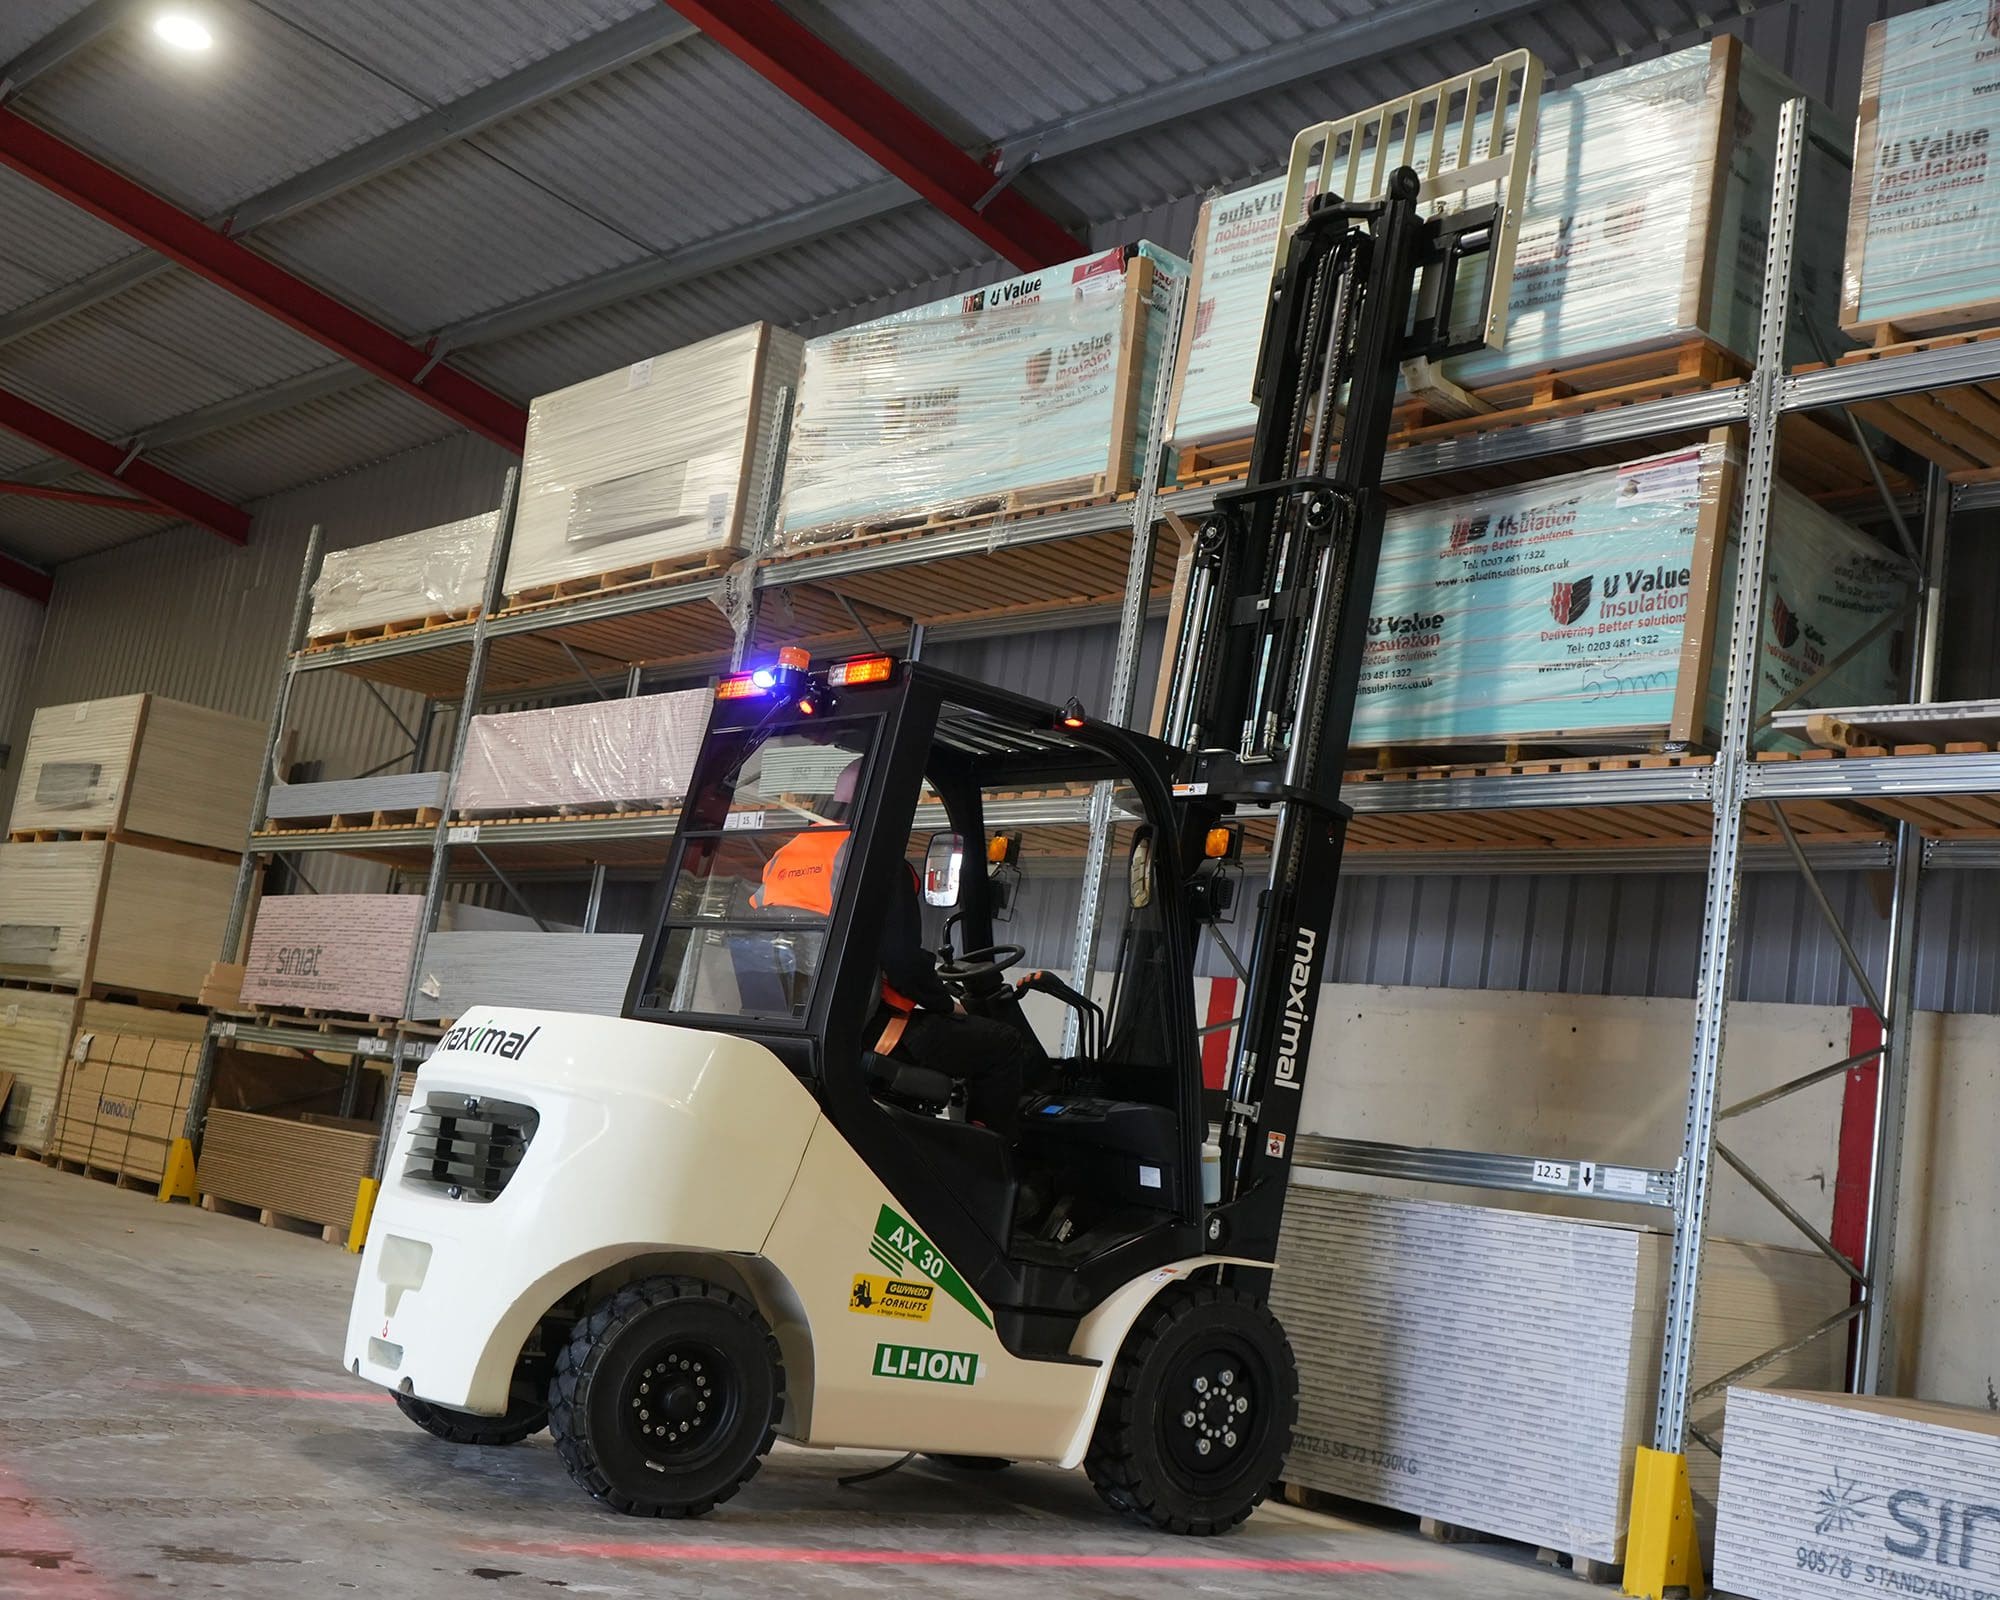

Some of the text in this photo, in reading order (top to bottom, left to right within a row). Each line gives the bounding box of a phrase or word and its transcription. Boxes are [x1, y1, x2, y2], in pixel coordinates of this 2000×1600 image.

[1908, 128, 1990, 162] Value
[990, 277, 1042, 306] U Value
[1491, 536, 1524, 551] Better
[1604, 565, 1691, 599] U Value
[1366, 611, 1445, 636] U Value
[1540, 612, 1687, 643] Delivering Better solutions
[1566, 643, 1585, 655] Tel:
[1587, 640, 1611, 652] 0203
[1613, 638, 1632, 648] 481
[1373, 670, 1389, 680] 481
[1391, 668, 1413, 679] 1322
[787, 863, 824, 879] maximal
[1274, 927, 1317, 1091] maximal
[438, 1019, 542, 1061] maximal
[1536, 1164, 1562, 1180] 12.5
[888, 1225, 945, 1279] AX 30
[889, 1283, 930, 1297] GWYNEDD
[879, 1297, 928, 1312] FORKLIFTS
[880, 1347, 972, 1382] LI-ION
[1331, 1441, 1349, 1460] SE
